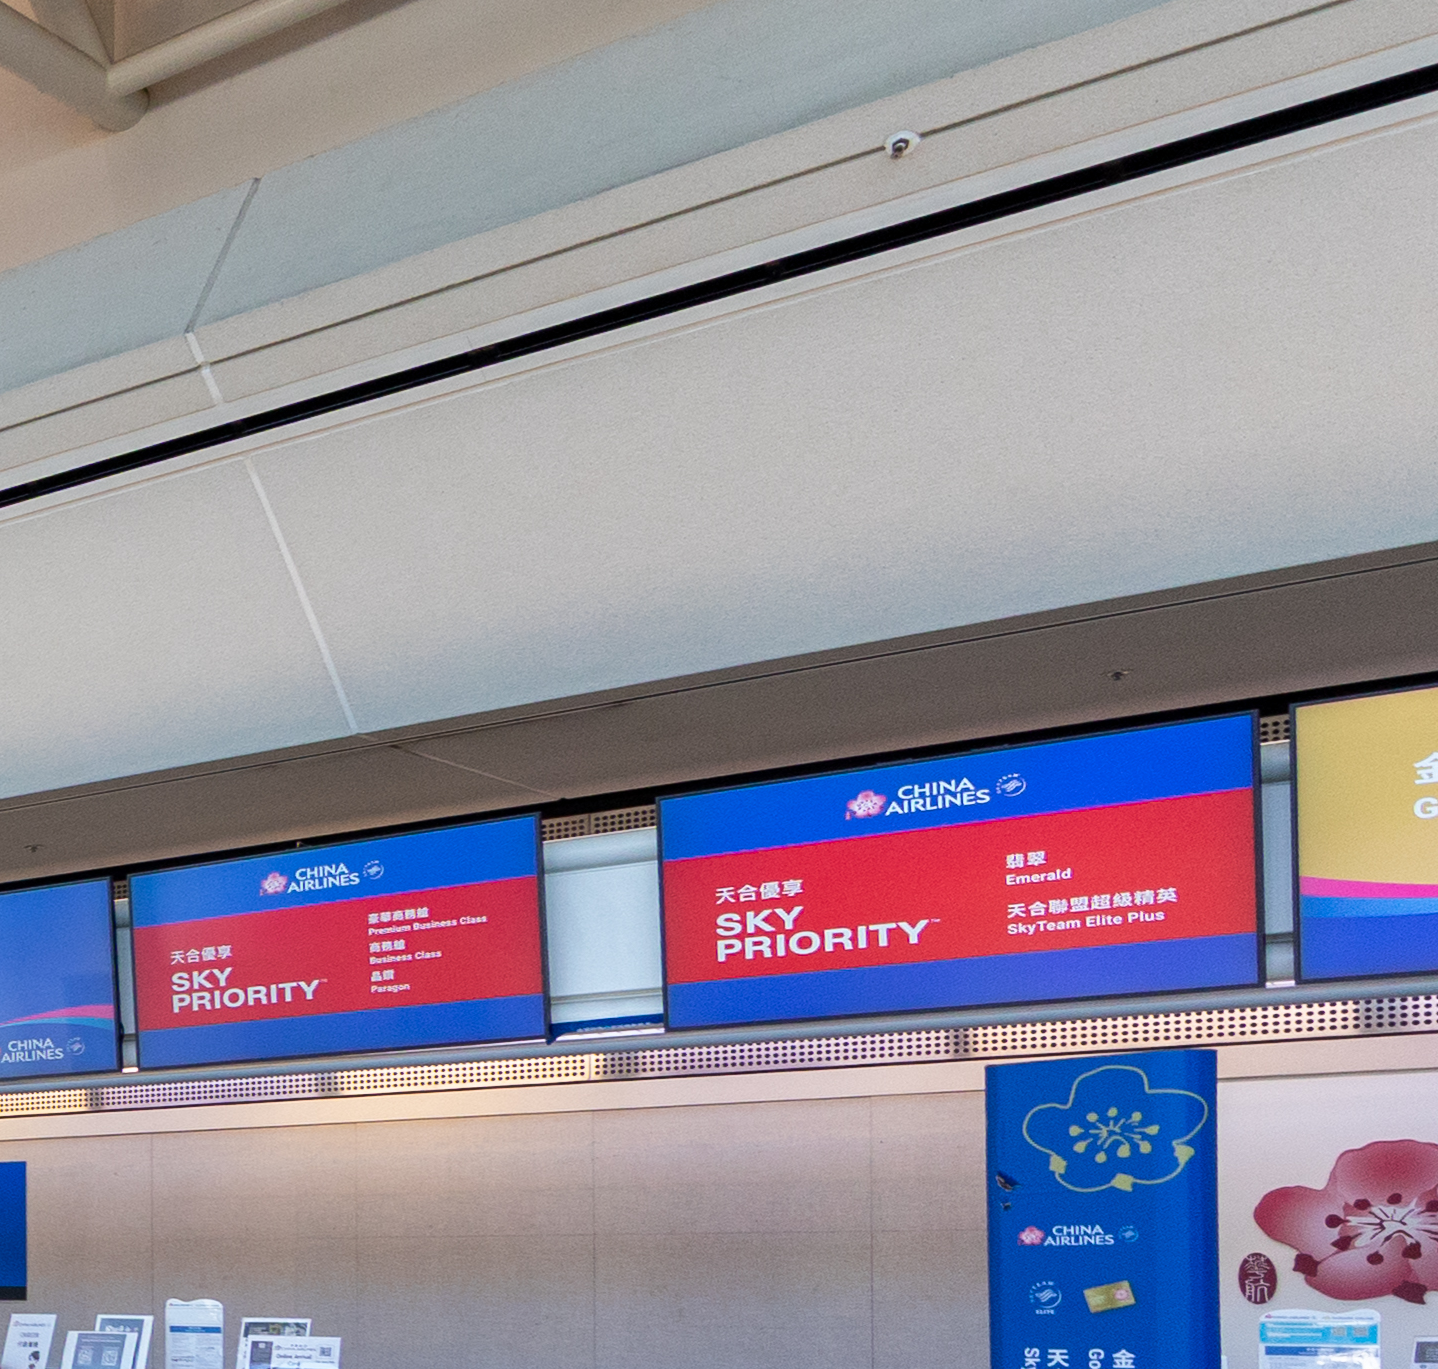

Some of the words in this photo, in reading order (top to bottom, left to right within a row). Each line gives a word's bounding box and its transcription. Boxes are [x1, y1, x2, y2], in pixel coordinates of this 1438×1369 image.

[897, 777, 976, 801] CHINA
[885, 789, 991, 817] AIRLINES
[1005, 850, 1048, 870] 翡翠
[295, 862, 350, 881] CHINA
[1005, 866, 1073, 887] Emerald
[287, 872, 360, 894] AIRLINES
[714, 878, 805, 905] 天合優享
[368, 924, 411, 936] Premium
[413, 918, 457, 931] Business
[459, 915, 488, 926] Class
[715, 905, 804, 938] SKY
[1006, 916, 1082, 937] SkyTeam
[1086, 912, 1123, 931] Elite
[1127, 907, 1166, 926] Plus
[716, 919, 931, 963] PRIORITY
[170, 944, 233, 965] 天合優享
[369, 953, 413, 965] Business
[414, 949, 442, 960] Class
[171, 967, 233, 992] SKY
[370, 983, 410, 994] Paragon
[172, 979, 320, 1014] PRIORITY
[8, 1038, 55, 1052] CHINA
[0, 1048, 64, 1064] AIRLINES
[1043, 1234, 1115, 1246] AIRLINES
[1052, 1224, 1105, 1236] CHINA
